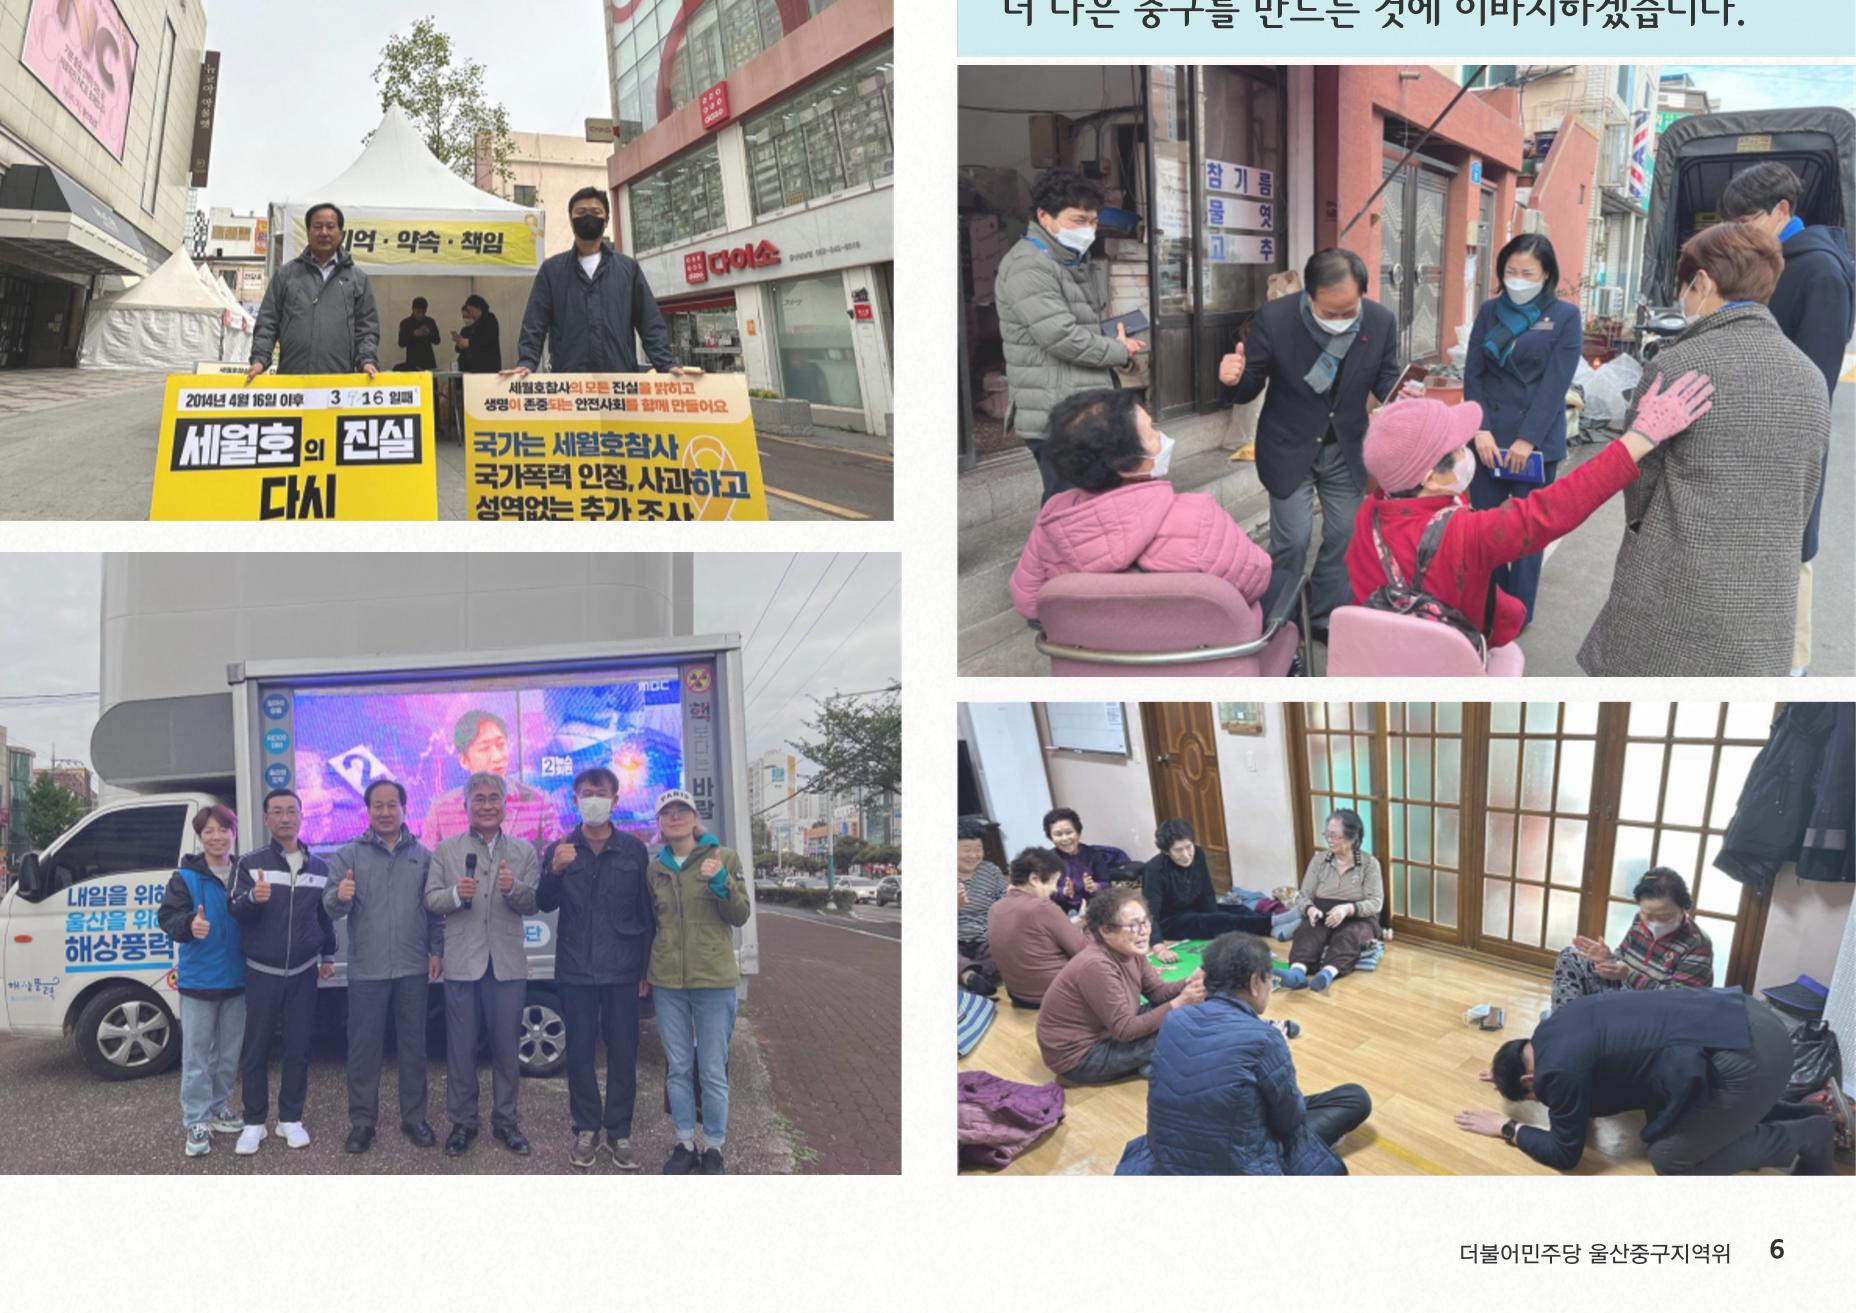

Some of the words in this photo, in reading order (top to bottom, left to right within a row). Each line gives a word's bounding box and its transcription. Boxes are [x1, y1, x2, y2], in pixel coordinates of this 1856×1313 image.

[1207, 162, 1272, 197] 참기름
[1208, 199, 1272, 229] 물엿
[397, 229, 441, 254] 약속
[461, 230, 504, 255] 책임
[1208, 235, 1273, 262] 고추
[708, 239, 782, 275] 다이소
[185, 392, 226, 409] 2014년
[229, 392, 249, 408] 4월
[252, 392, 278, 407] 16일
[279, 391, 304, 407] 이후
[508, 381, 584, 395] 세월호참사의
[585, 381, 610, 395] 모든
[612, 381, 652, 395] 진실을
[654, 382, 696, 396] 밝히고
[484, 398, 521, 412] 생명이
[523, 398, 573, 412] 존중되는
[575, 398, 639, 413] 안전사회를
[641, 399, 670, 413] 함께
[672, 399, 729, 415] 만들어요
[179, 422, 294, 467] 세월호
[304, 439, 325, 462] 의
[342, 418, 415, 461] 진실
[473, 431, 546, 458] 국가는
[553, 431, 680, 461] 세월호참사
[474, 463, 572, 490] 국가폭력
[578, 463, 635, 494] 인정,
[638, 466, 751, 500] 사과하고
[259, 473, 337, 520] 다시
[476, 496, 574, 521] 성역없는
[580, 497, 632, 521] 추가
[638, 498, 695, 521] 조사
[660, 790, 690, 803] PARIS
[67, 885, 128, 907] 내일을
[65, 910, 127, 933] 울산을
[132, 909, 160, 930] 위
[65, 933, 174, 963] 해상풍력
[1460, 1243, 1582, 1265] 더불어민주당
[1588, 1243, 1730, 1265] 울산중구지역위
[1770, 1238, 1785, 1260] 6
